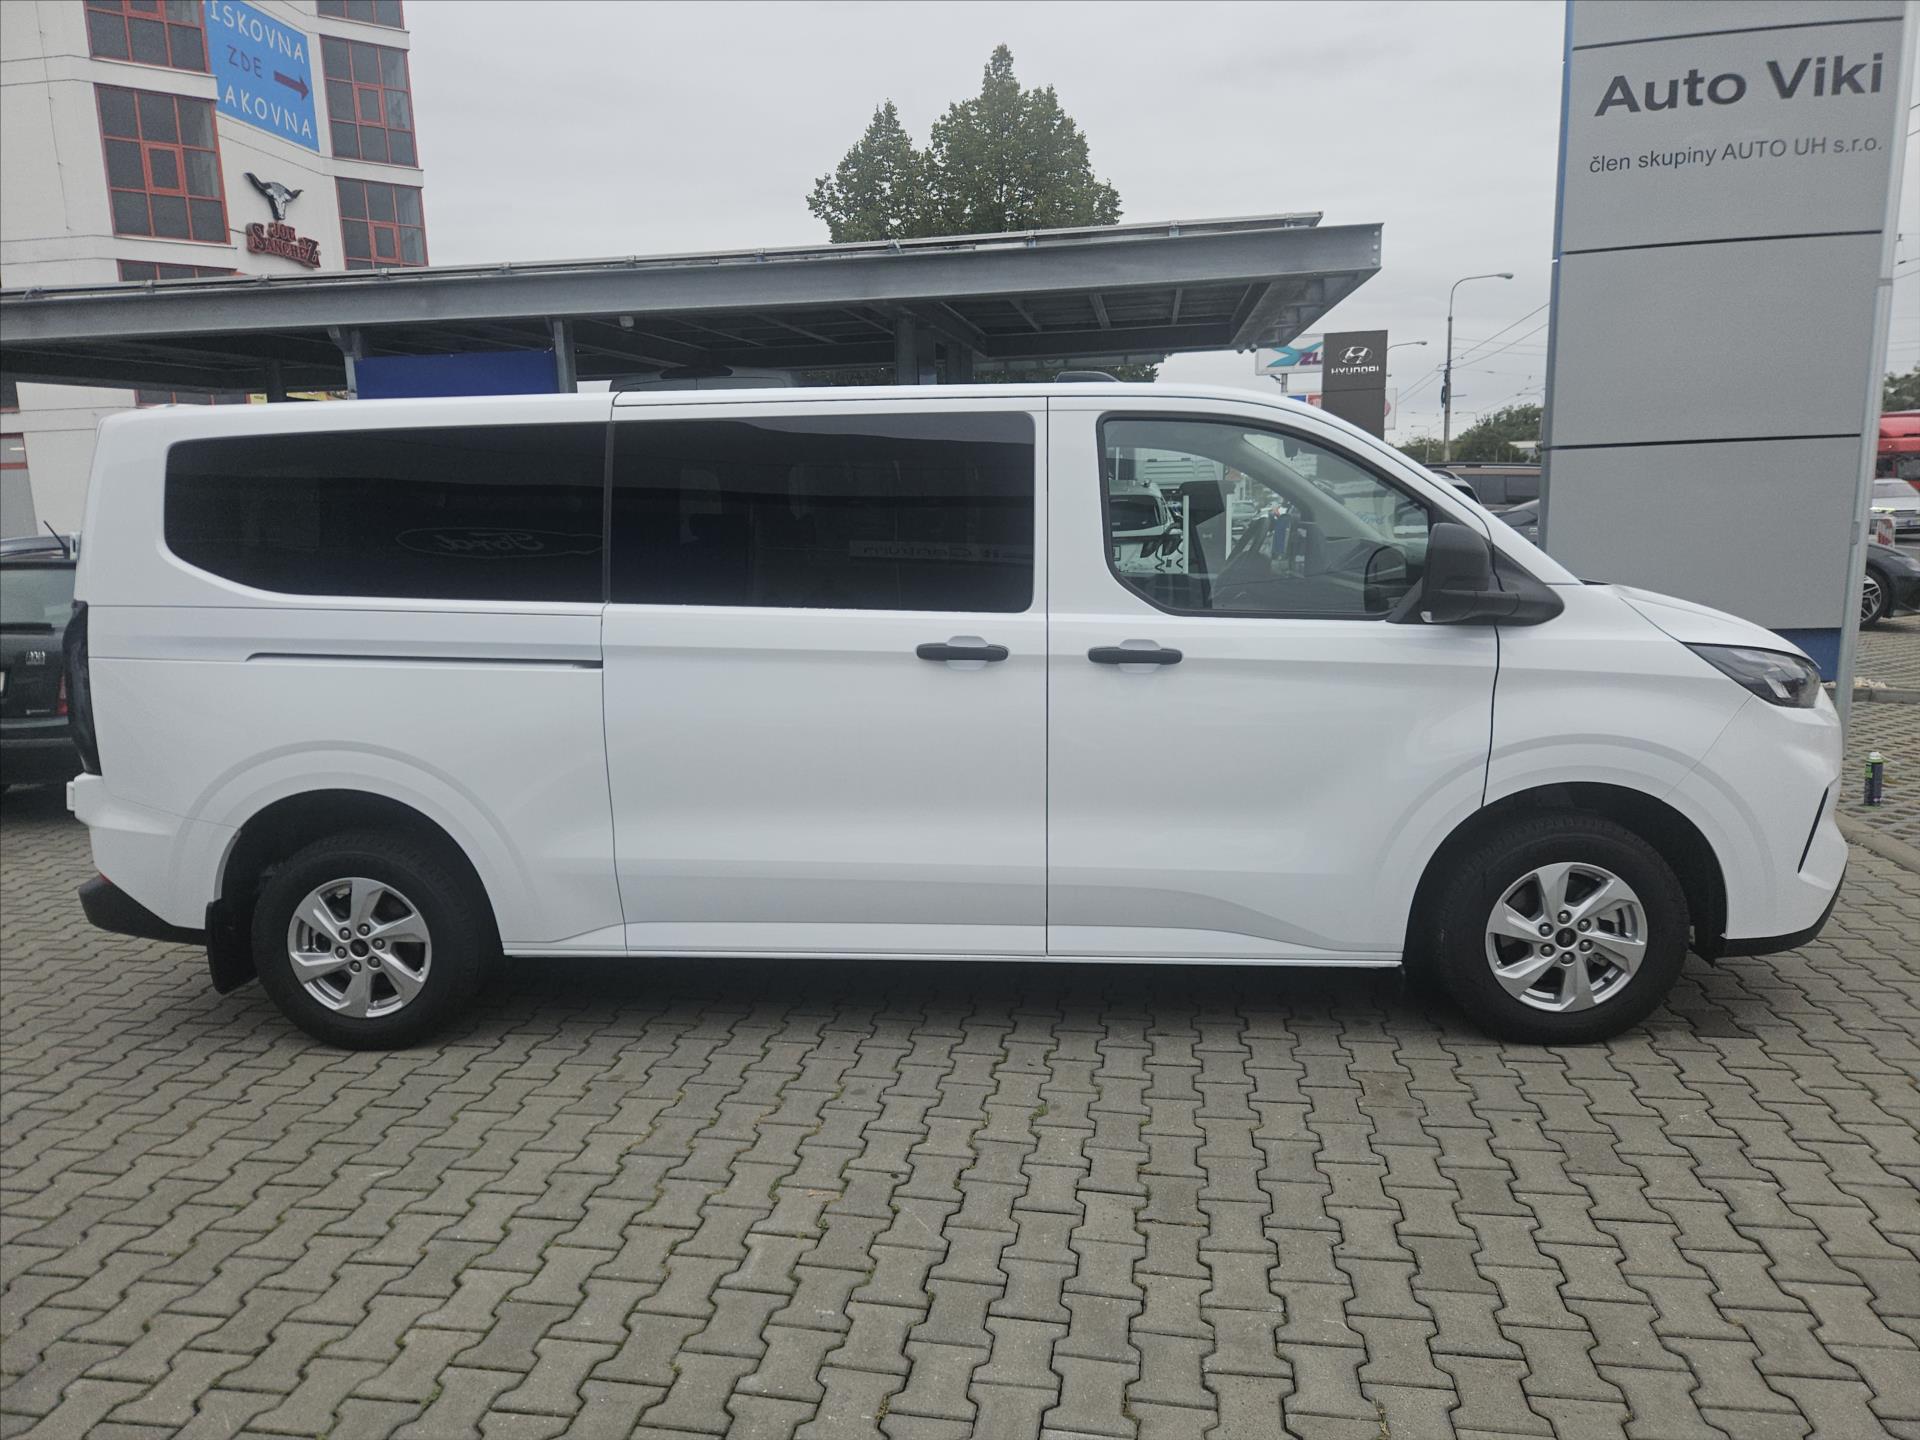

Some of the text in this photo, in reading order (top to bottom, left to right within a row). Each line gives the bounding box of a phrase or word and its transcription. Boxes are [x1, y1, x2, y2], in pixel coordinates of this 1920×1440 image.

[204, 0, 305, 64] ISKOVNA
[227, 44, 263, 79] ZDE
[1594, 52, 1884, 117] Auto Viki
[220, 85, 312, 139] AKOVNA
[1589, 137, 1882, 173] člen skupiny AUTO UH s.r.o.
[1299, 352, 1323, 365] ZL
[1331, 365, 1379, 376] HYUNDAI
